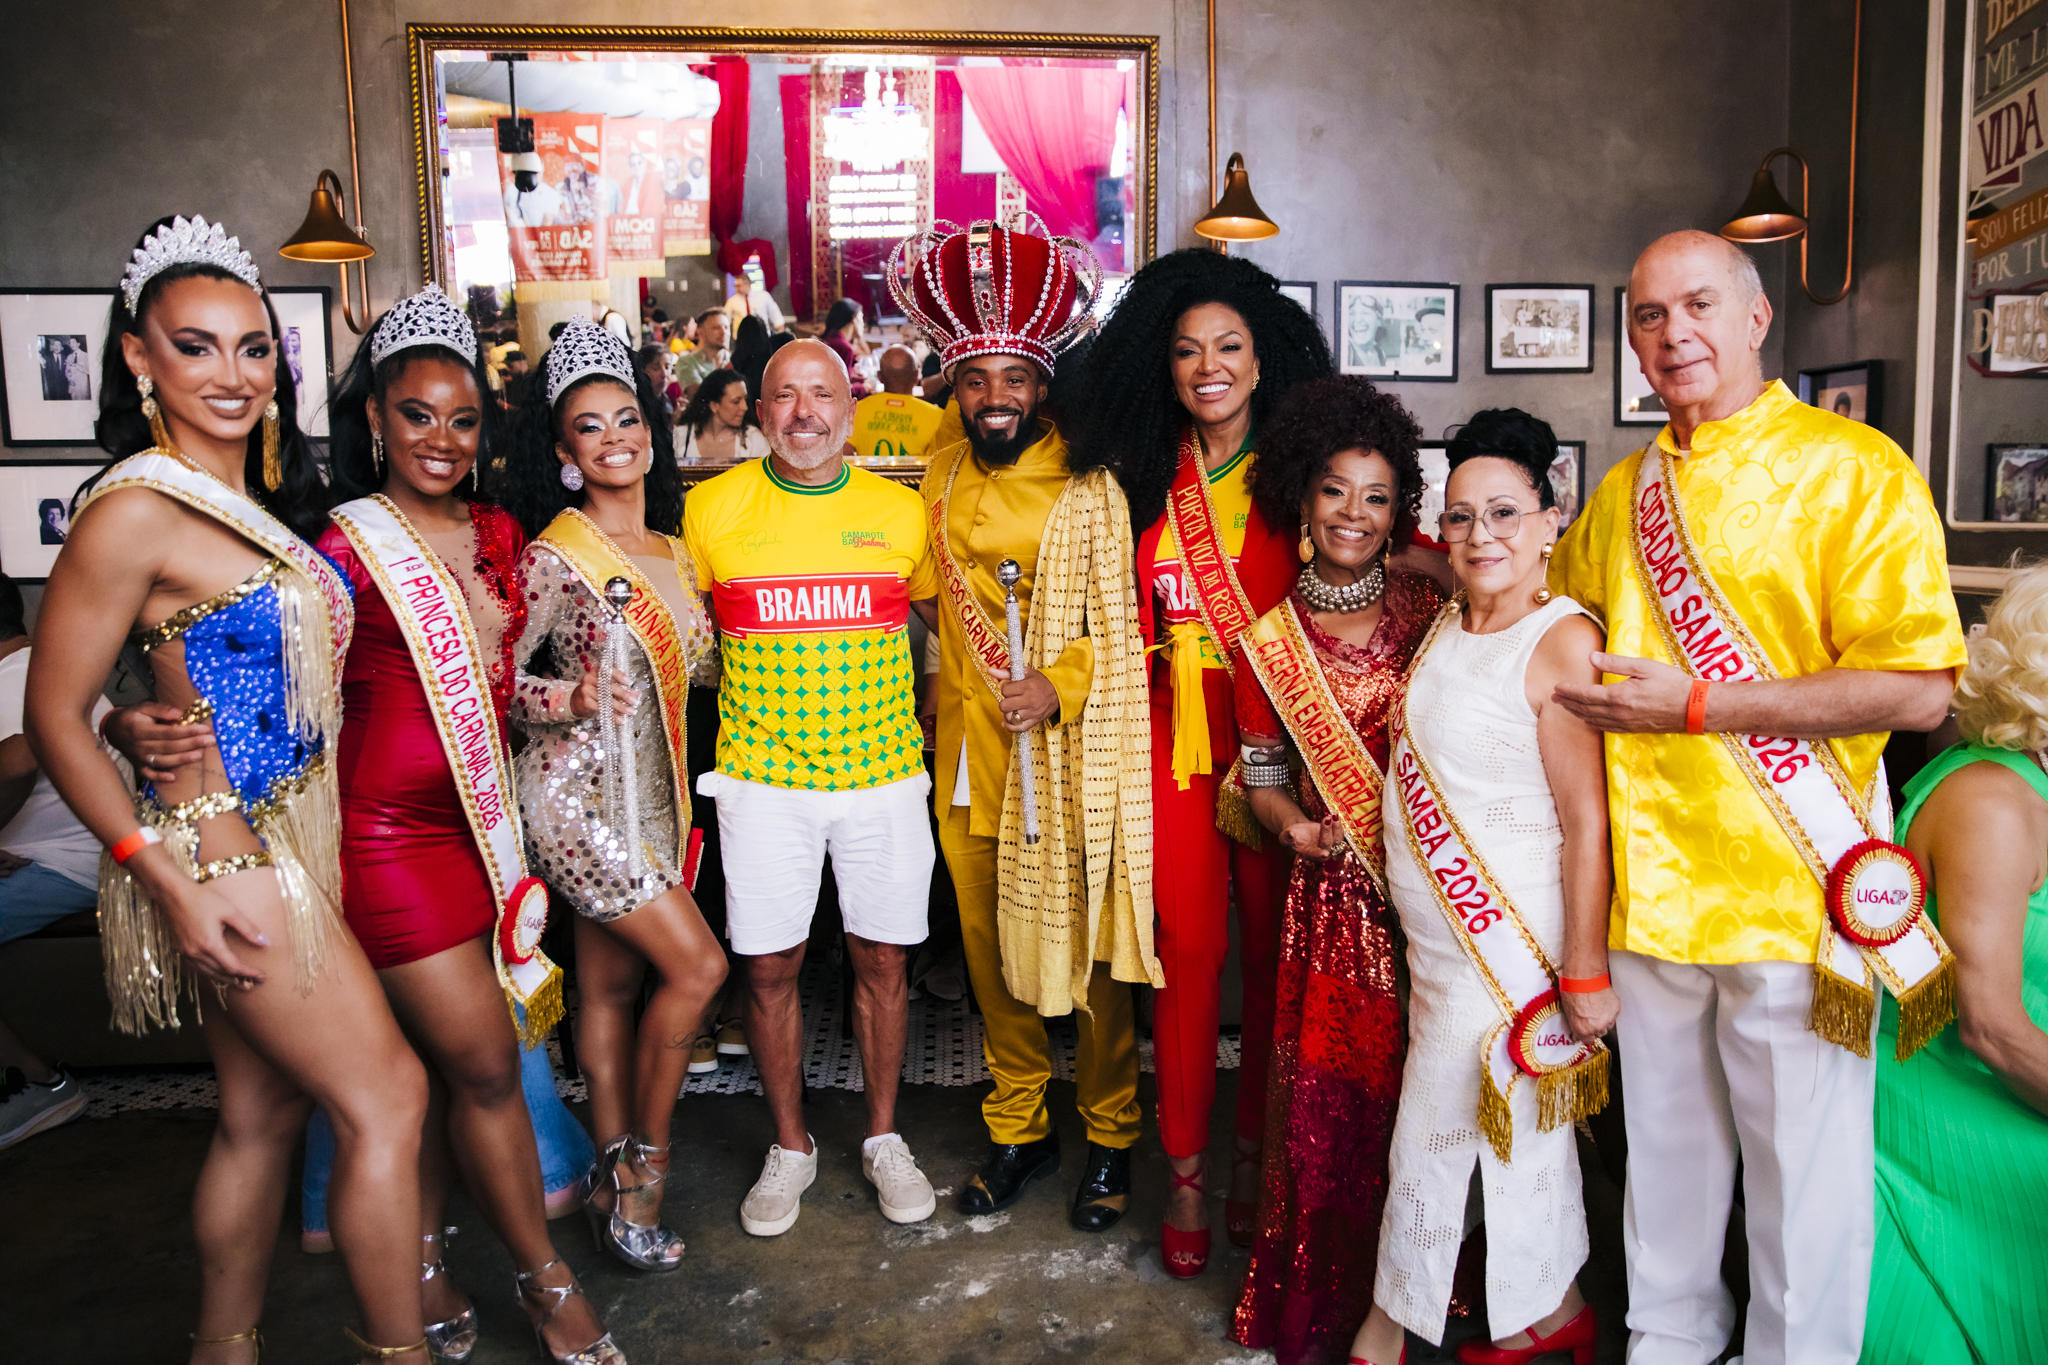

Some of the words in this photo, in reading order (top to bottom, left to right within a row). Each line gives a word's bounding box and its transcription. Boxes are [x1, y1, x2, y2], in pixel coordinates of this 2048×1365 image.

[1983, 38, 2020, 96] ME
[1977, 87, 2045, 176] VIDA
[1980, 215, 2008, 249] SOU
[1977, 251, 2017, 286] POR
[841, 531, 886, 540] CAMAROTE
[1177, 482, 1208, 540] PORTA
[388, 556, 425, 572] 1ª
[853, 536, 892, 551] Brahma
[1187, 535, 1218, 572] VOZ
[755, 584, 872, 622] BRAHMA
[1203, 569, 1219, 591] DA
[400, 574, 463, 669] PRINCESA
[623, 586, 672, 659] RAINHA
[661, 652, 679, 686] DO
[950, 576, 965, 605] DO
[961, 604, 1011, 670] CARNAVA
[1669, 594, 1754, 682] SAMB
[439, 664, 471, 697] DO
[450, 697, 493, 790] CARNAVAL
[1260, 636, 1310, 707] ETERNA
[1295, 701, 1376, 814] EMBAIXATRIZ
[474, 783, 504, 831] 2026
[1397, 752, 1452, 860] SAMBA
[1435, 857, 1502, 935] 2026
